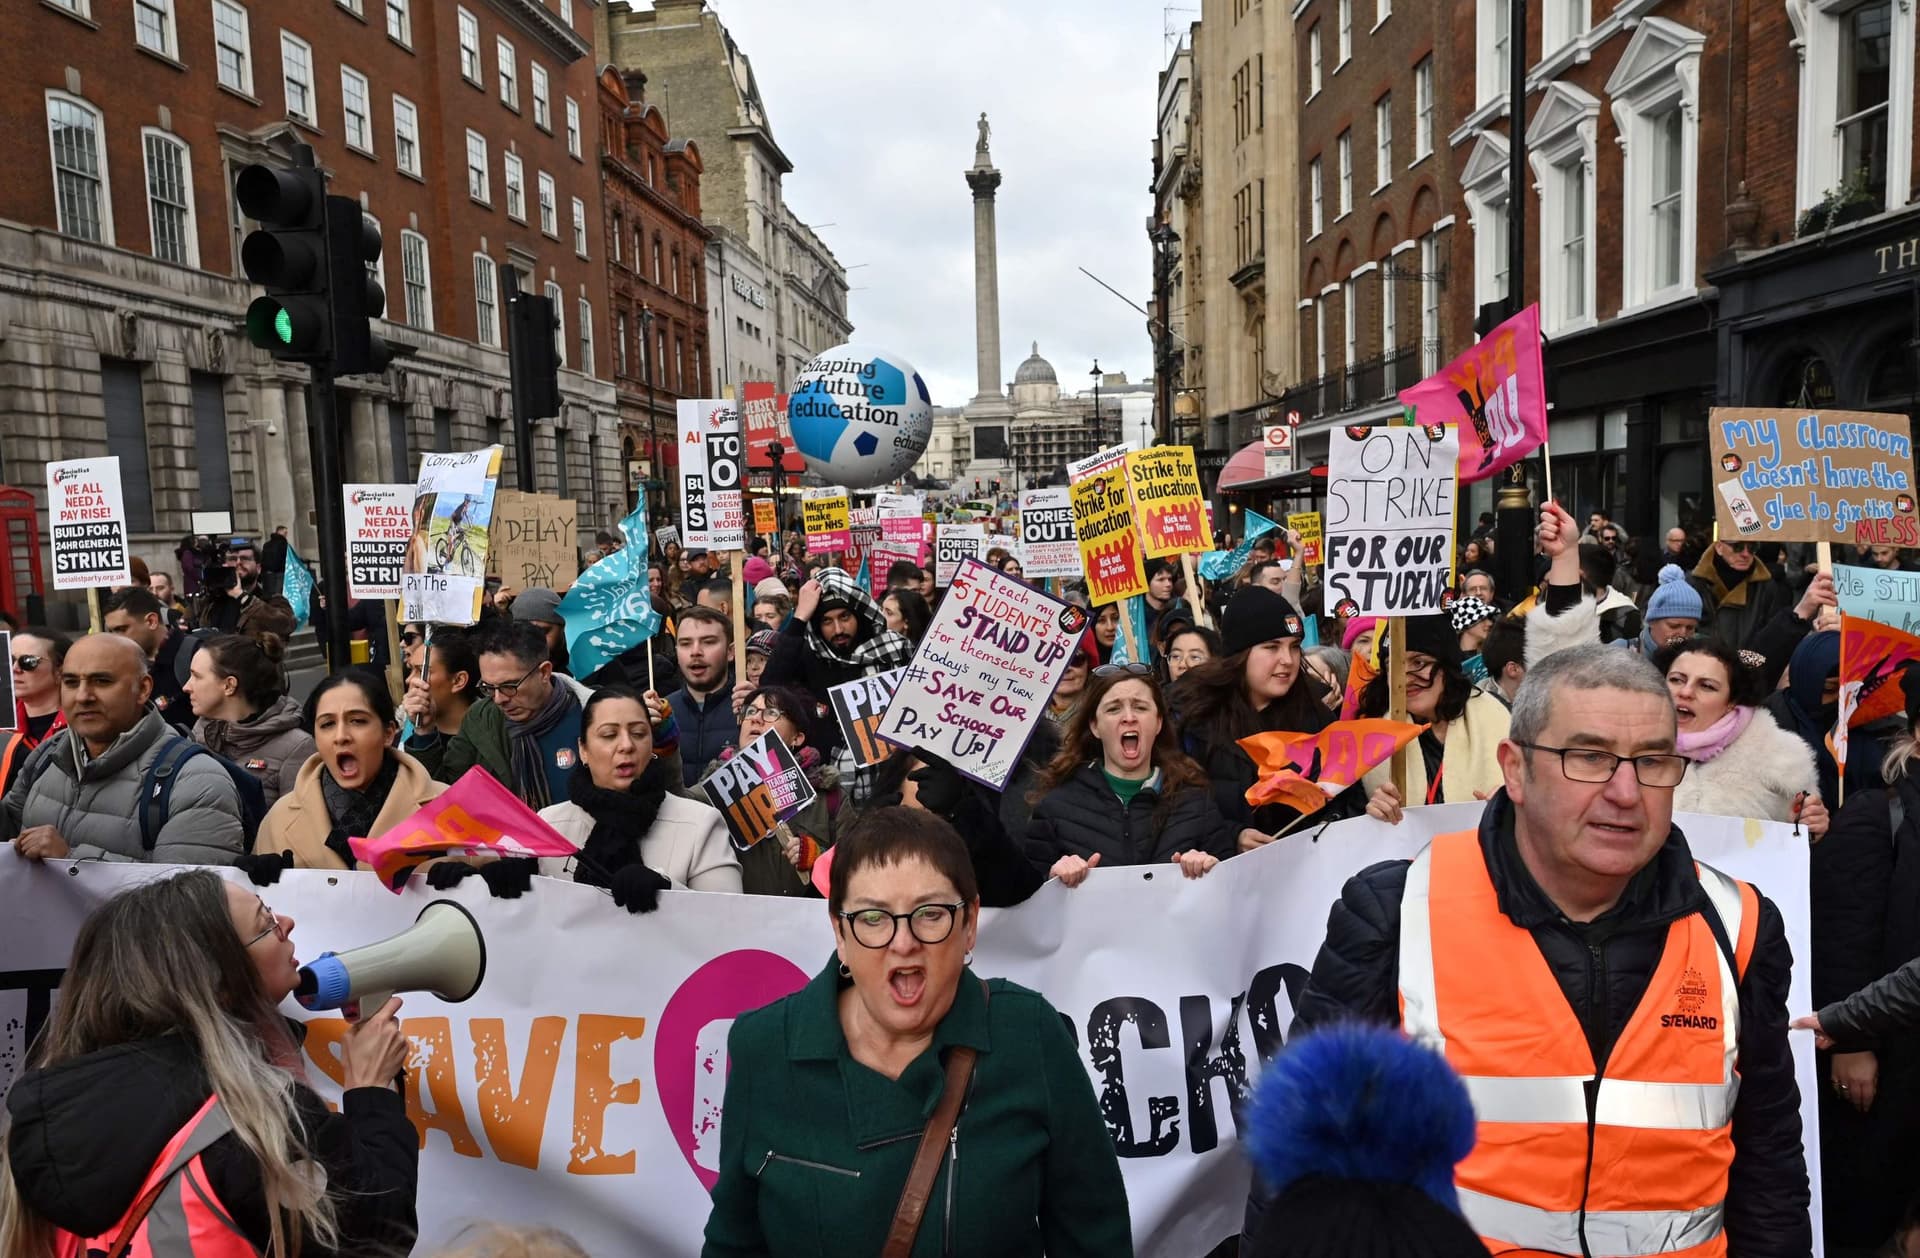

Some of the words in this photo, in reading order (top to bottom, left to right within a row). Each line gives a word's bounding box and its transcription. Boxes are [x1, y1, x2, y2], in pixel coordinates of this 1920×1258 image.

[816, 375, 884, 400] future
[746, 398, 776, 414] JERSEY
[795, 397, 898, 426] education
[748, 412, 776, 431] BOYS
[1288, 412, 1299, 424] N
[1361, 432, 1432, 474] ON
[1721, 418, 1781, 470] my
[1077, 454, 1104, 472] Socialist
[1138, 451, 1165, 462] Socialist
[60, 468, 90, 476] Socialist
[1132, 460, 1174, 482] Strike
[1176, 459, 1192, 478] for
[1740, 458, 1820, 490] doesn't
[1824, 456, 1870, 488] have
[1872, 461, 1909, 490] the
[64, 484, 79, 495] WE
[82, 482, 103, 494] ALL
[1138, 478, 1198, 502] education
[66, 496, 94, 508] NEED
[96, 495, 104, 506] A
[805, 500, 845, 512] Migrants
[1074, 494, 1106, 520] Strike
[1108, 486, 1125, 506] for
[1330, 477, 1454, 525] STRIKE
[60, 510, 79, 520] PAY
[81, 508, 111, 519] RISE!
[364, 506, 382, 516] WE
[386, 506, 408, 516] ALL
[806, 512, 831, 522] make
[1024, 509, 1074, 524] TORIES
[1765, 492, 1804, 530] glue
[1809, 492, 1830, 520] to
[1834, 499, 1862, 532] fix
[1864, 499, 1894, 520] this
[55, 526, 84, 539] BUILD
[86, 524, 110, 536] FOR
[112, 524, 120, 534] A
[364, 518, 397, 527] NEED
[400, 518, 408, 527] A
[808, 524, 824, 532] our
[825, 520, 844, 530] NHS
[1026, 522, 1076, 541] OUT!
[1079, 508, 1132, 542] education
[1856, 516, 1919, 546] MESS
[358, 528, 380, 538] PAY
[505, 516, 574, 548] DELAY
[56, 541, 78, 551] 24HR
[78, 538, 122, 549] GENERAL
[352, 544, 386, 554] BUILD
[389, 544, 407, 554] FO
[940, 540, 978, 549] TORIES
[1328, 535, 1386, 569] FOR
[1395, 534, 1446, 567] OUR
[57, 550, 123, 570] STRIKE
[352, 556, 378, 564] 24HR
[378, 556, 405, 564] GENE
[354, 567, 402, 582] STRI
[424, 575, 448, 591] The
[522, 562, 560, 589] PAY
[1834, 568, 1864, 596] We
[962, 562, 984, 582] I
[990, 574, 1029, 605] teach
[1036, 603, 1055, 623] my
[954, 582, 1052, 638] STUDENTS
[1056, 631, 1071, 648] to
[954, 606, 1030, 654] STAND
[1034, 640, 1066, 668] UP
[930, 623, 953, 644] for
[960, 636, 1034, 680] themselves
[923, 642, 970, 677] today's
[978, 671, 1000, 690] my
[710, 736, 774, 806] PAY
[766, 770, 798, 788] TEACHERS
[770, 781, 798, 798] DESERVE
[774, 792, 798, 808] BETTER
[1660, 1014, 1717, 1030] STEWARD
